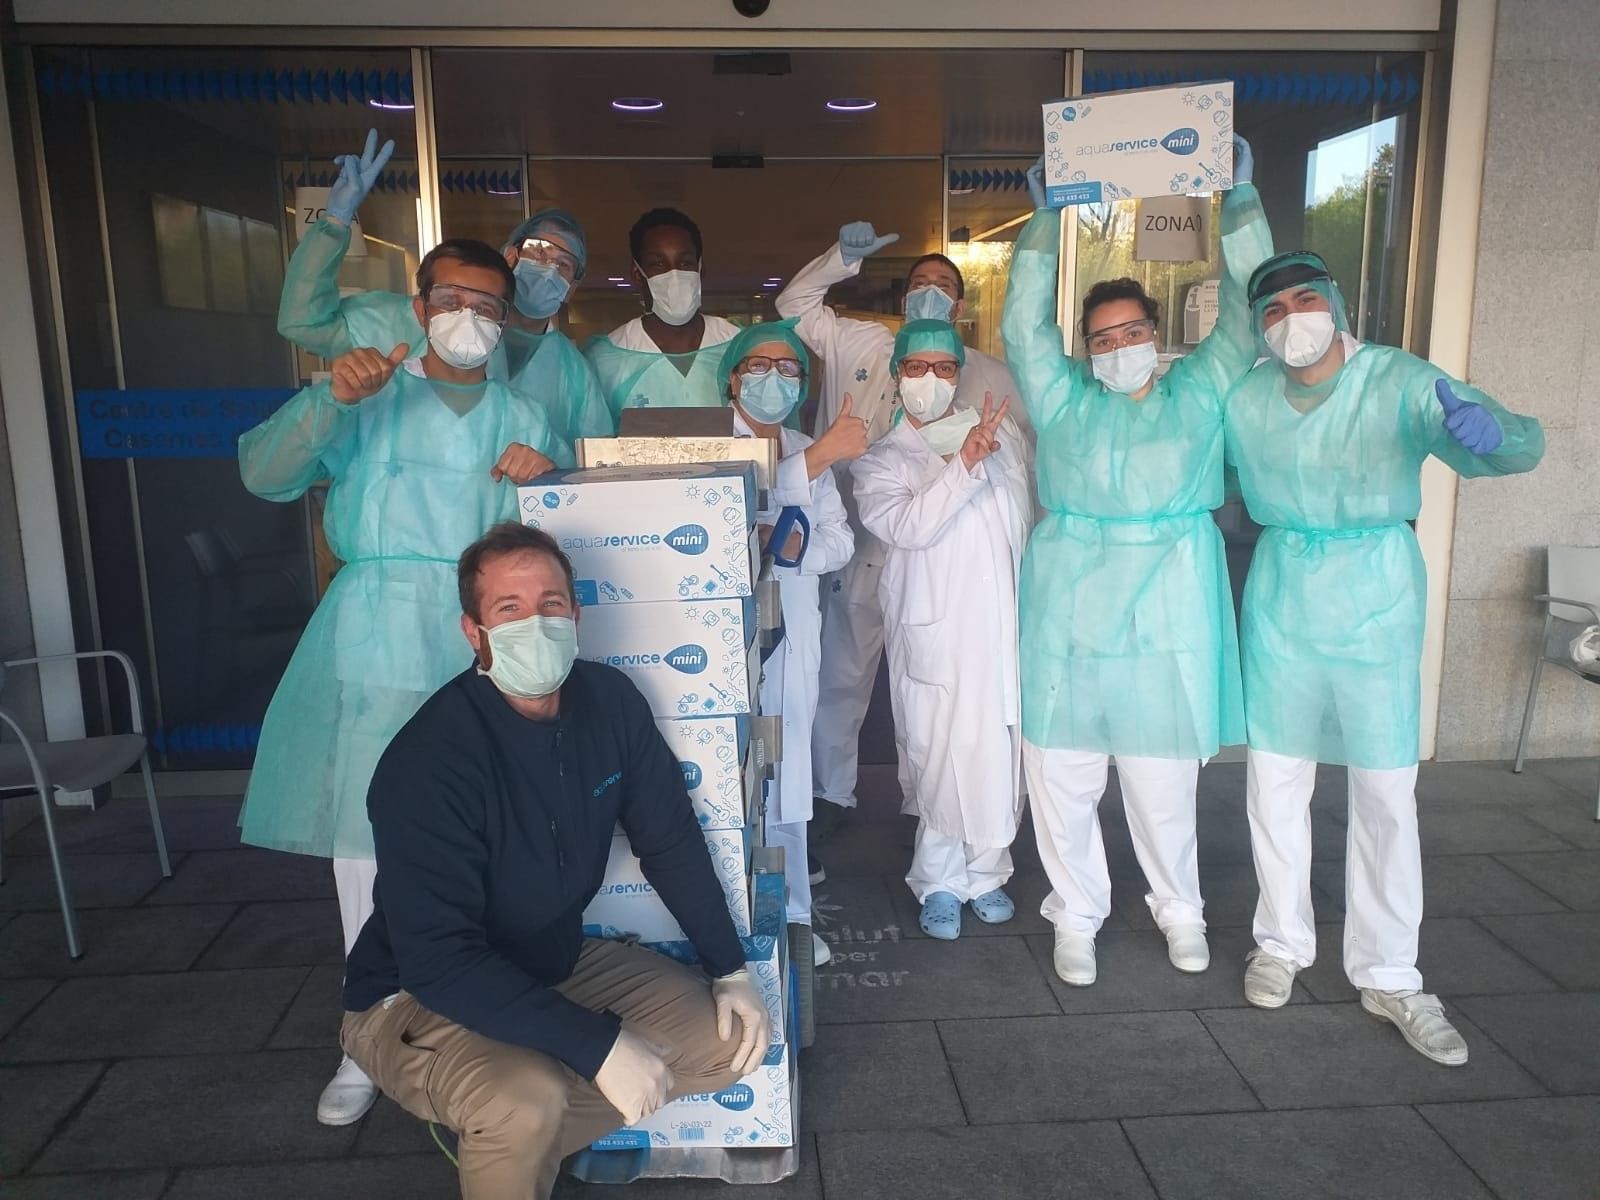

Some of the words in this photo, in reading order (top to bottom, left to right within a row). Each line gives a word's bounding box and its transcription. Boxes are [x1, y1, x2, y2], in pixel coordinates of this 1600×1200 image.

[1075, 137, 1158, 157] aquaservice
[1167, 134, 1194, 148] mini
[1145, 215, 1196, 232] ZONA
[562, 533, 661, 551] aquaservice
[672, 532, 703, 546] mini
[672, 652, 702, 665] mini
[683, 768, 697, 781] ni
[720, 1090, 749, 1104] mini
